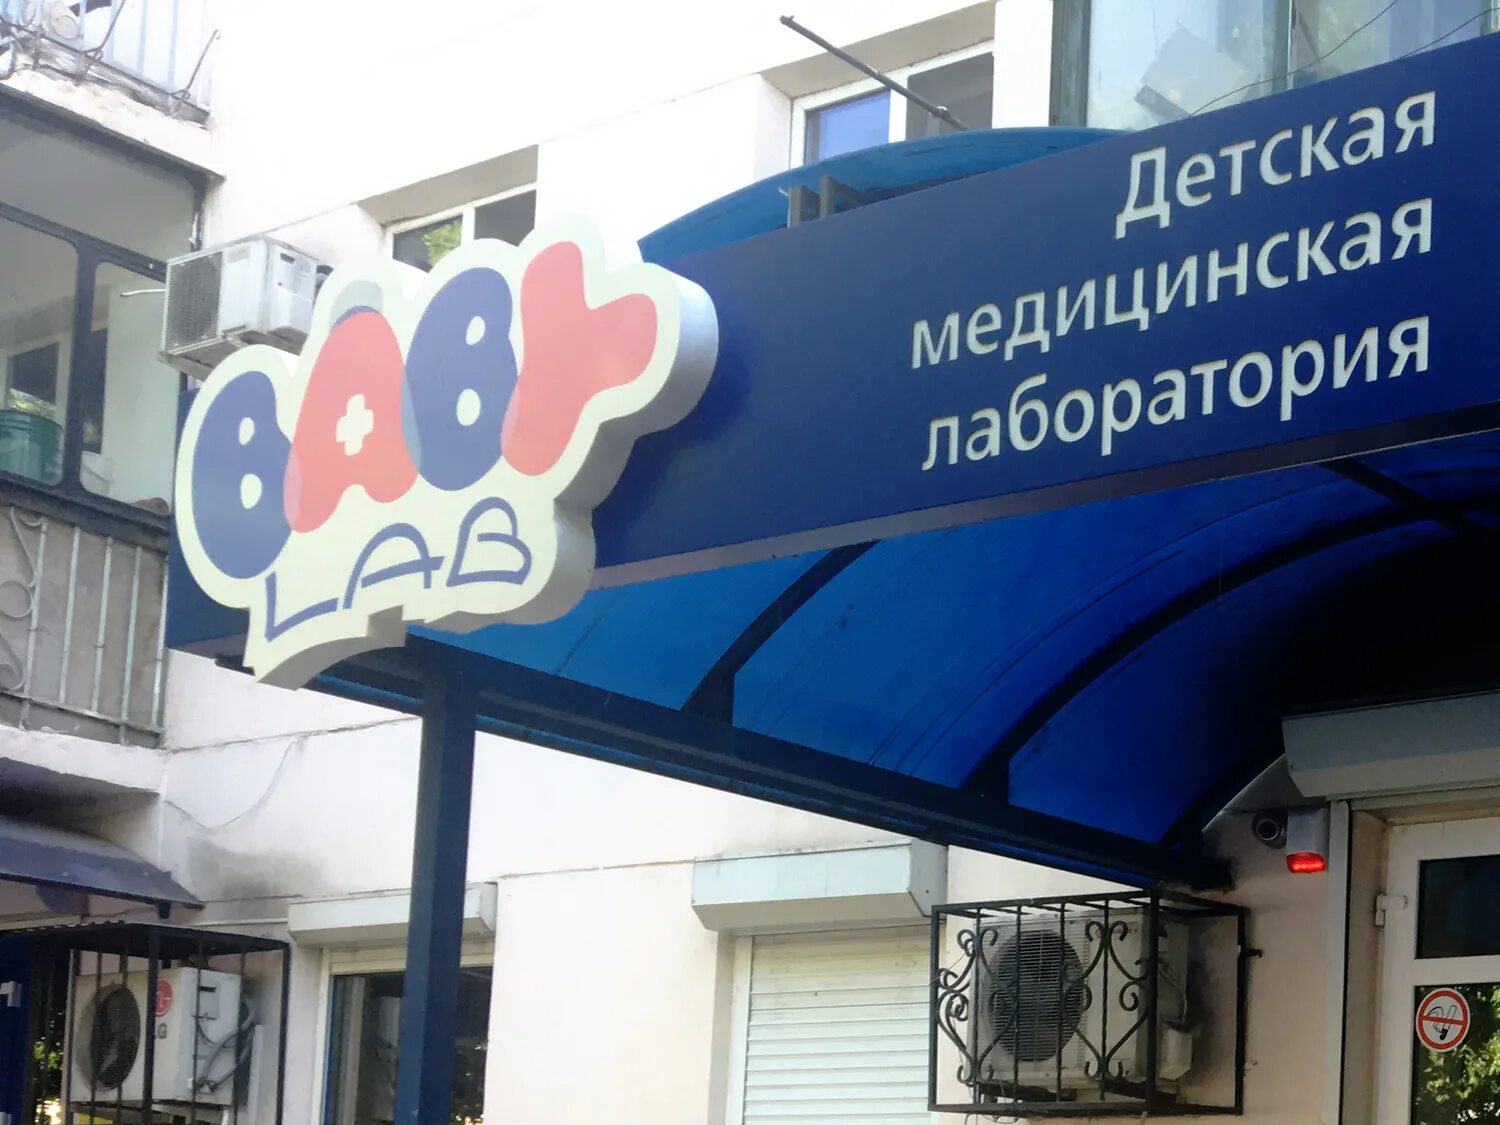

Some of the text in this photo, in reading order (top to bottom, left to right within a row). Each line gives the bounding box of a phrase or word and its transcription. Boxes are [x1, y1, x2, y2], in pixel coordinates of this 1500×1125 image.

[1115, 90, 1436, 239] Детская
[911, 198, 1433, 370] медицинская
[192, 240, 658, 580] BABY
[921, 315, 1430, 471] лаборатория
[265, 496, 532, 642] LAB
